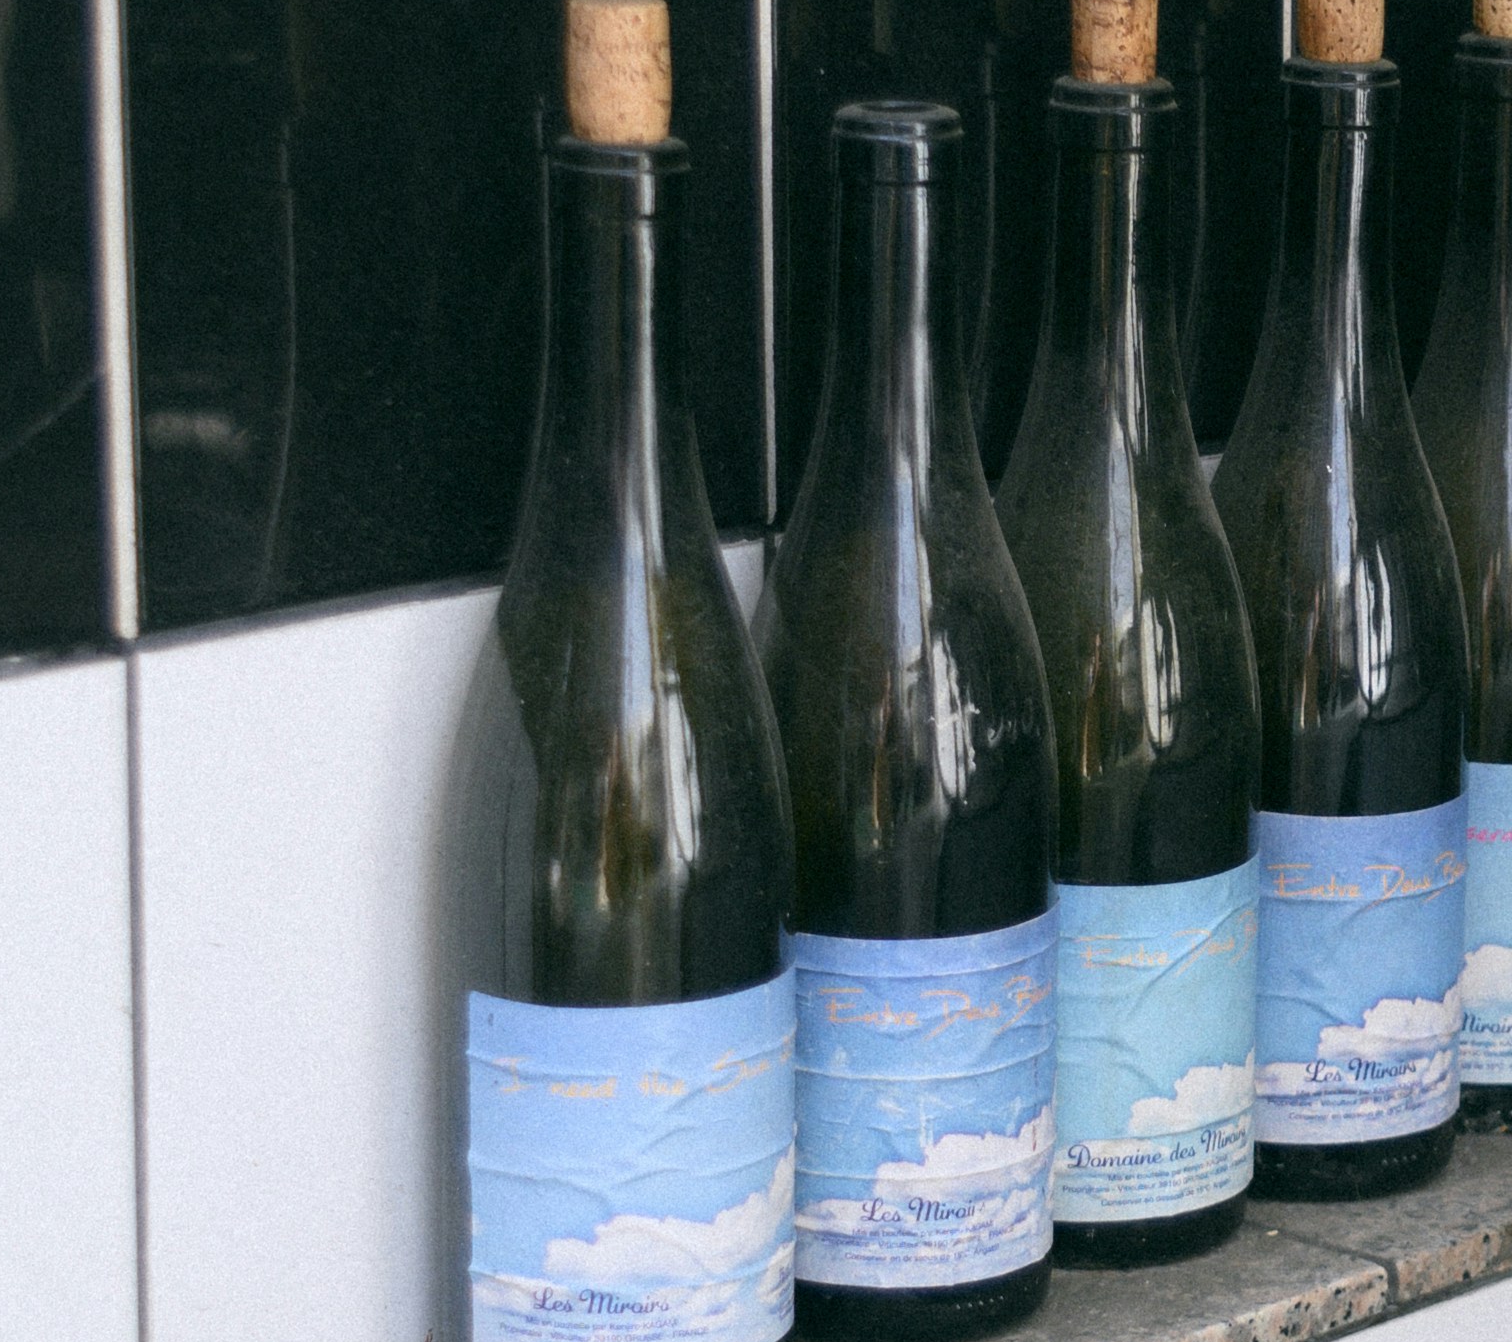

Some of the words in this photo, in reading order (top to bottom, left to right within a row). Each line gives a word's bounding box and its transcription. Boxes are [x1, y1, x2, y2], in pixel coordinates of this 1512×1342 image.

[1267, 862, 1358, 899] Entre
[818, 986, 921, 1026] Entre
[549, 1075, 618, 1099] need
[639, 1068, 688, 1097] the
[1305, 1059, 1342, 1083] Les
[1348, 1057, 1417, 1082] Miroirs
[1067, 1143, 1162, 1169] Domaine
[1169, 1141, 1196, 1162] des
[861, 1196, 902, 1223] Les
[532, 1286, 573, 1313] Les
[579, 1288, 670, 1315] Miroirs
